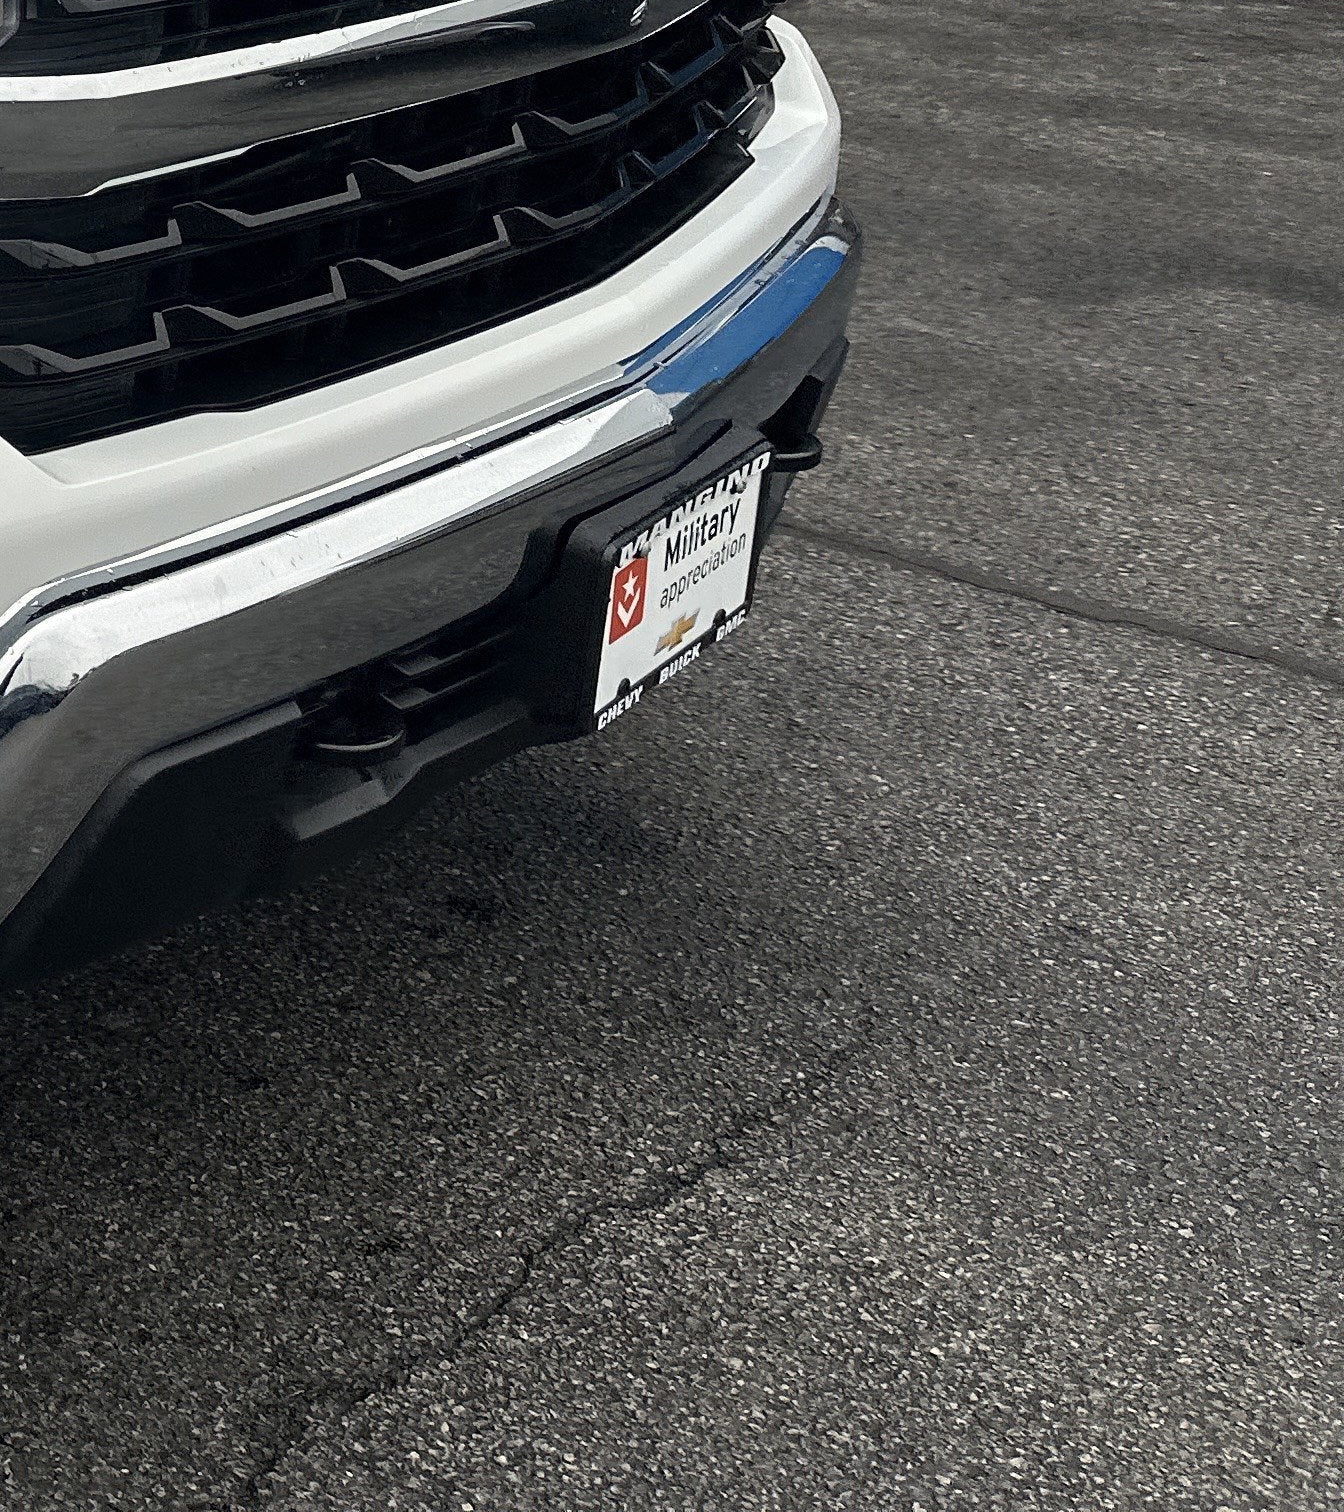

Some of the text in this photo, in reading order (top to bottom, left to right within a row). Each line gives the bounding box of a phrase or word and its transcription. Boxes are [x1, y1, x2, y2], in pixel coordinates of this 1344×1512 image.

[659, 532, 747, 608] appreciation
[664, 498, 741, 572] Military
[598, 609, 747, 731] CHEVY BUICK GMC
